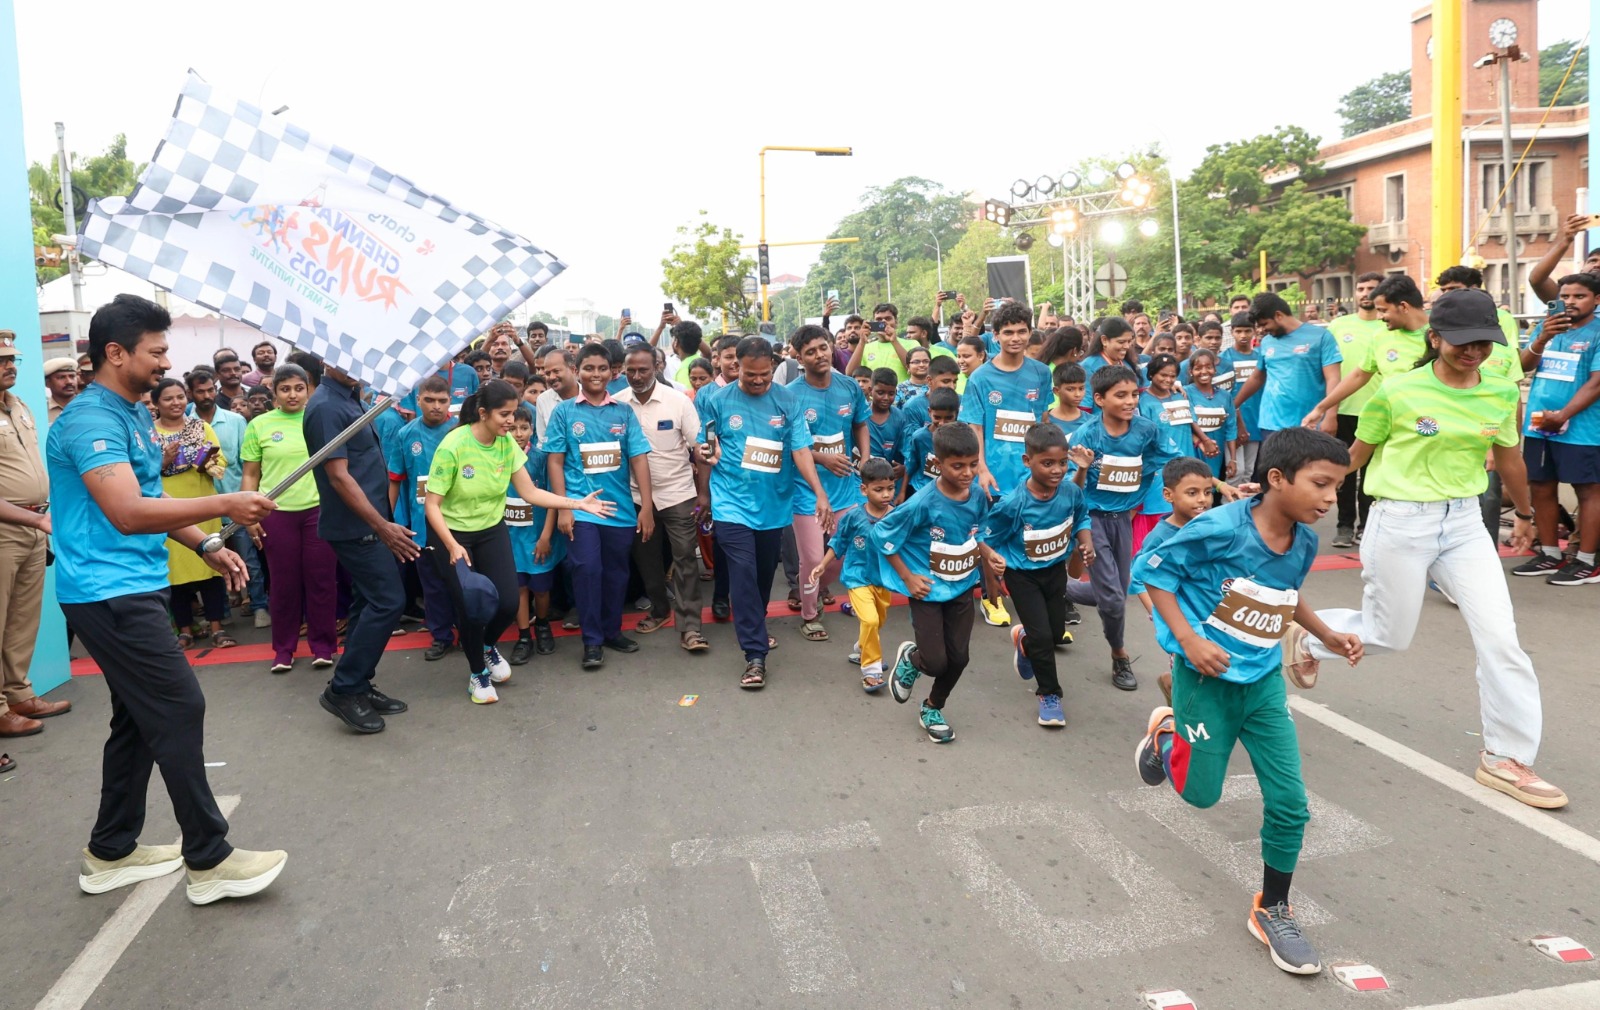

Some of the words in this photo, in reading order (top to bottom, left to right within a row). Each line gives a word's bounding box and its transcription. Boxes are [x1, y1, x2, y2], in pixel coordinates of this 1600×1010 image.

[587, 453, 614, 466] 60007
[750, 450, 779, 465] 60049
[1108, 470, 1139, 483] 60043
[1035, 537, 1069, 555] 60044
[939, 555, 975, 572] 60068
[1232, 606, 1283, 633] 60038
[1184, 722, 1211, 743] M
